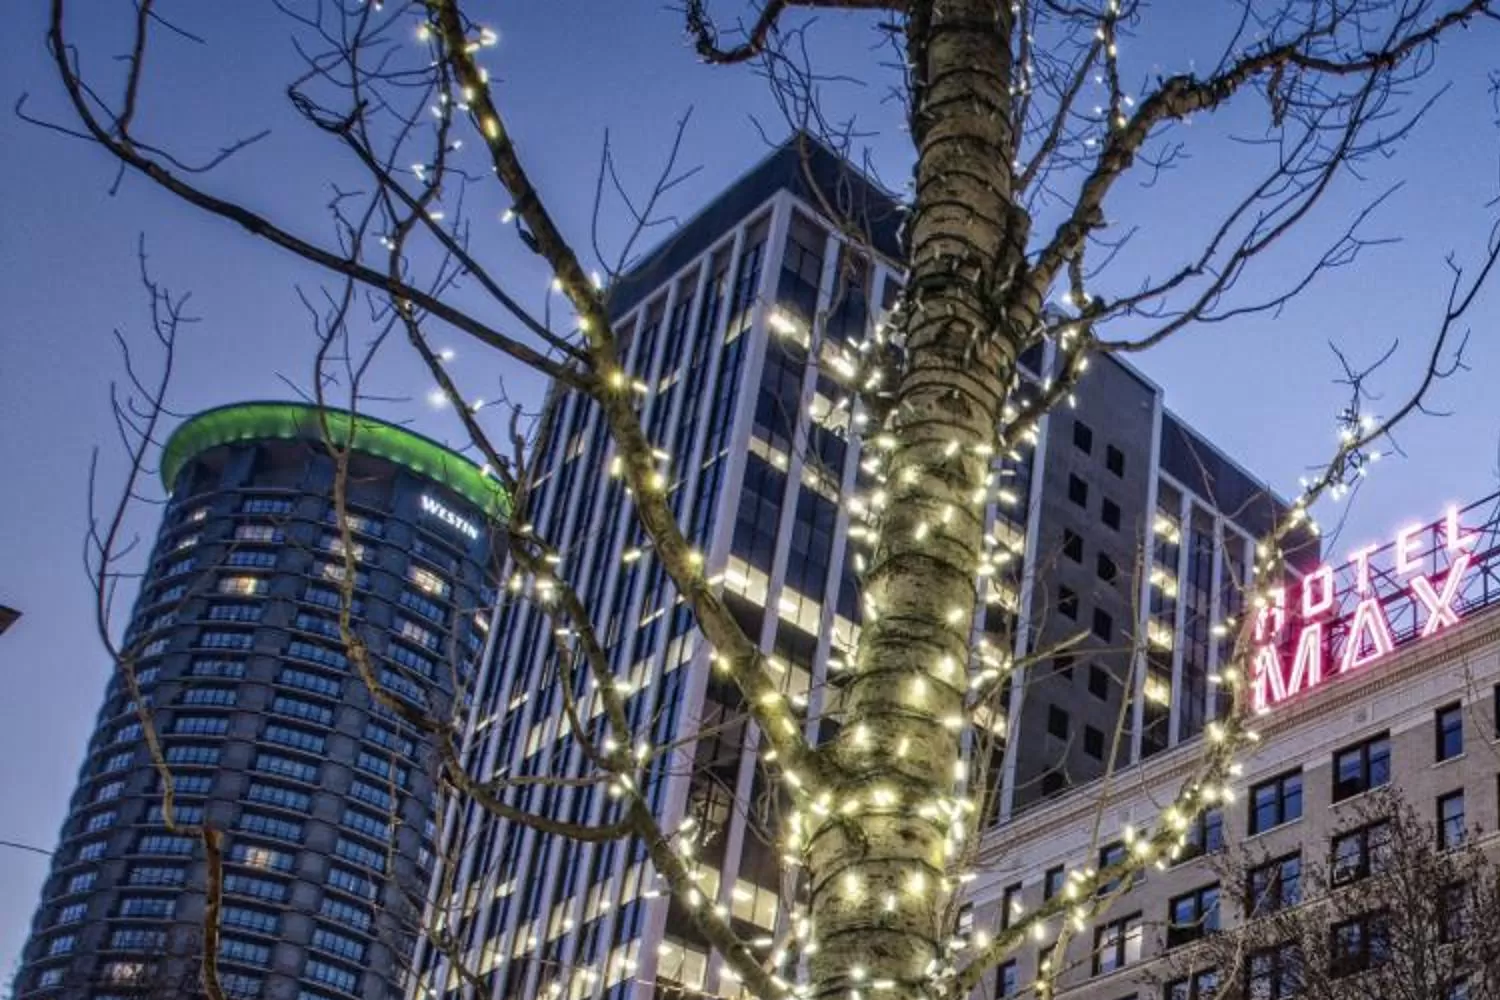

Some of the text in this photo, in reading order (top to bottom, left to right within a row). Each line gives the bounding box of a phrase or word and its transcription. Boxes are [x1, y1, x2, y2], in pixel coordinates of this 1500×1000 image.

[421, 495, 479, 539] WESTIN
[1255, 504, 1477, 640] HOTEL
[1254, 555, 1470, 714] MAX
